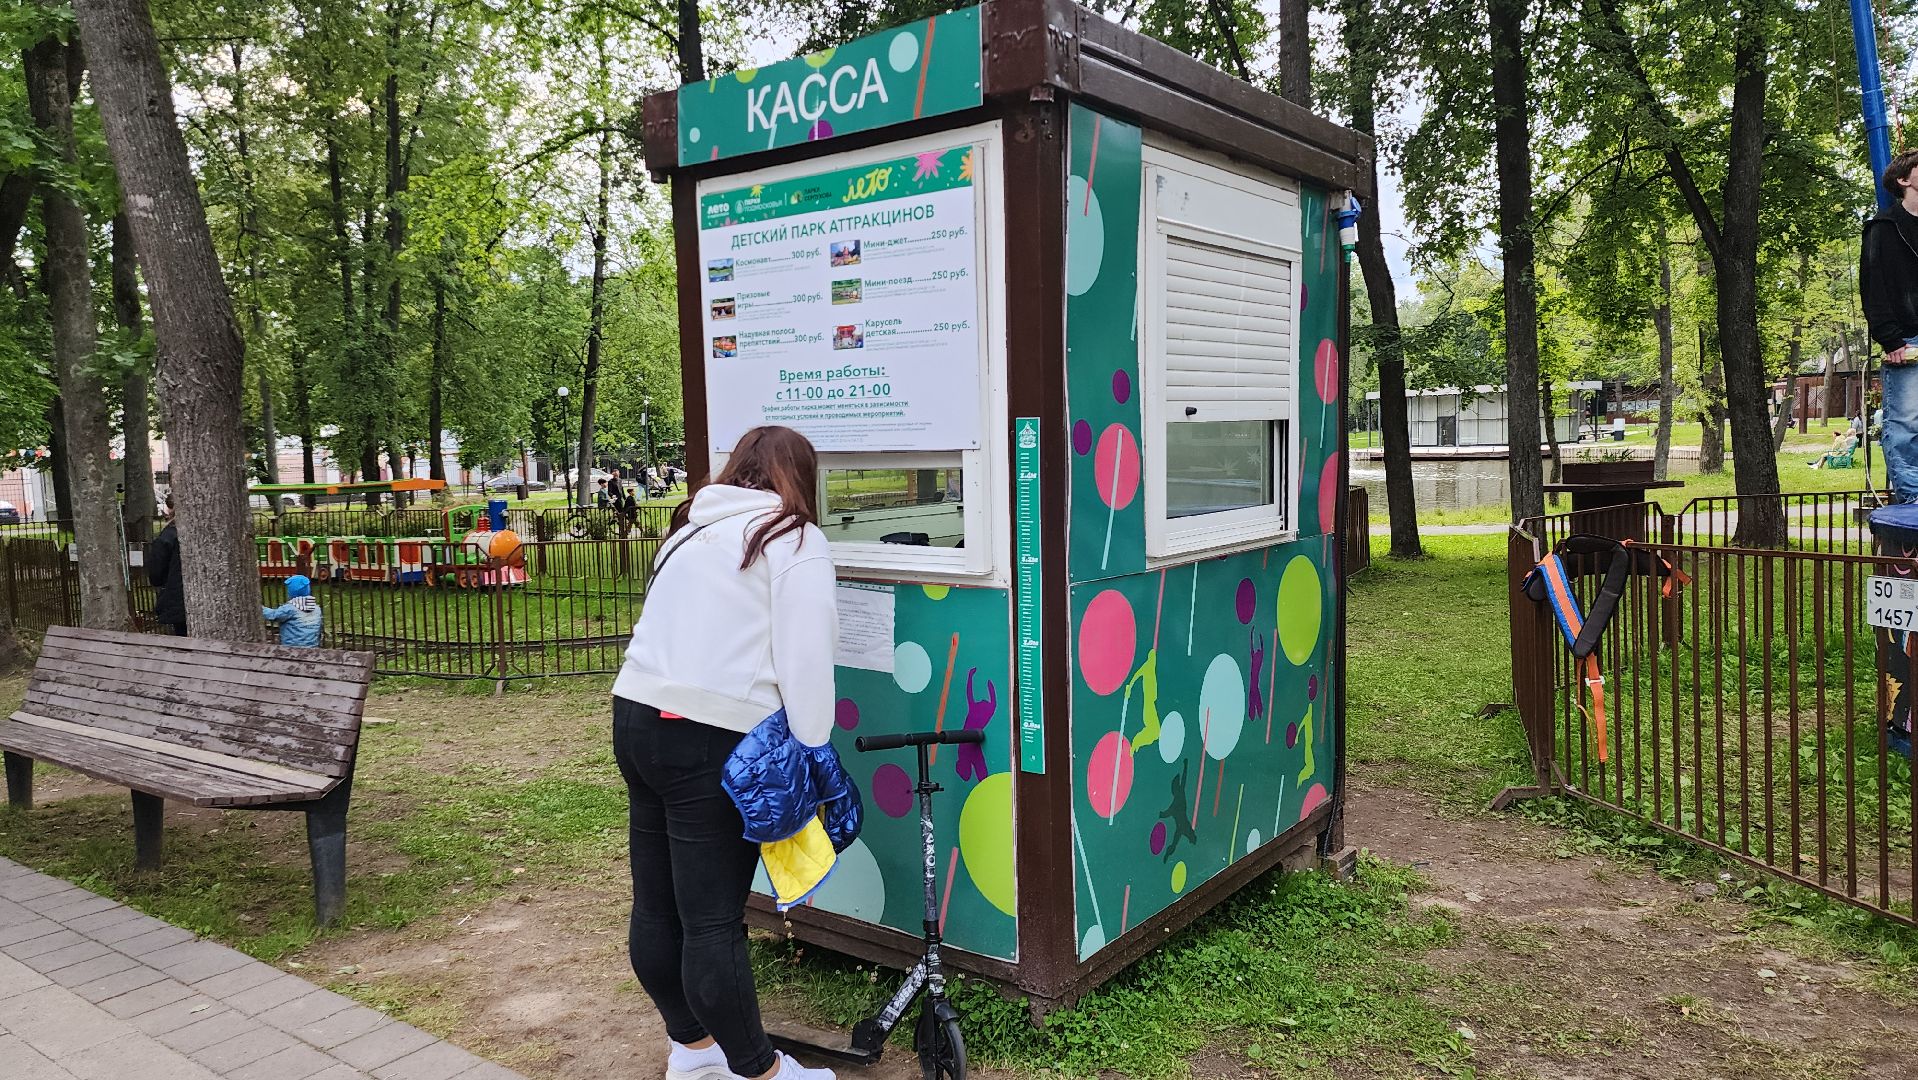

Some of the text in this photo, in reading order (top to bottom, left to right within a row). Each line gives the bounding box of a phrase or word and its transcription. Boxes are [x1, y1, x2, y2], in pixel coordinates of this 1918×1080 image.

[748, 58, 888, 133] КАССА
[731, 204, 935, 251] ДЕТСКИЙ ПАРК АТТРАКЦИНОВ
[931, 229, 947, 240] 250
[949, 226, 967, 239] руб.
[791, 250, 804, 259] 300
[806, 247, 821, 258] руб.
[932, 270, 948, 280] 250
[950, 267, 968, 280] руб.
[793, 294, 806, 303] 300
[807, 292, 823, 303] руб.
[865, 318, 902, 329] Карусель
[933, 322, 949, 331] 250
[951, 320, 970, 332] руб.
[794, 334, 807, 343] 300
[808, 332, 824, 344] руб.
[780, 364, 885, 384] Время работы:
[776, 383, 891, 399] с 11-00 до 21-00
[1875, 581, 1893, 598] 50
[1875, 607, 1913, 627] 1457
